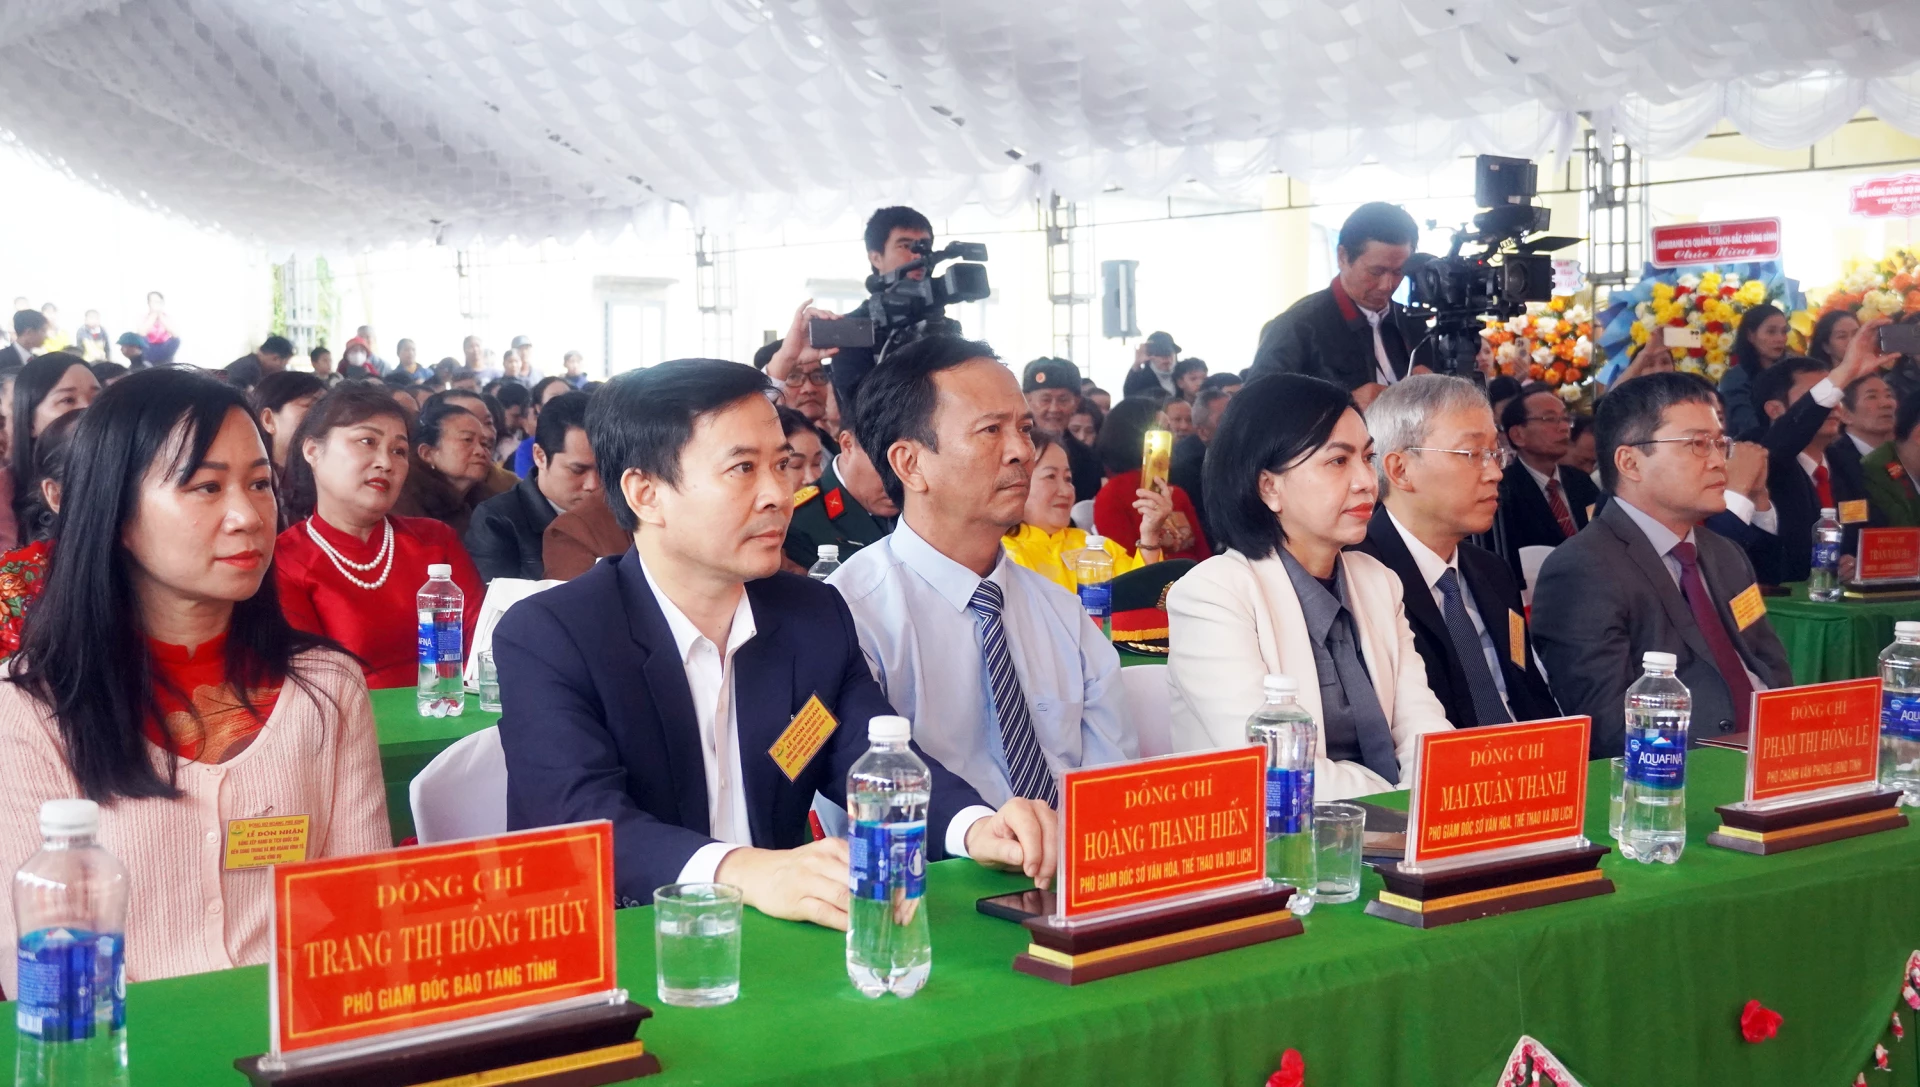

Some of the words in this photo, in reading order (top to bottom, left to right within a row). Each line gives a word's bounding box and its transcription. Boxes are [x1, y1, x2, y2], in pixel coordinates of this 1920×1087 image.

[1674, 248, 1709, 259] Chúc
[1791, 700, 1824, 720] ĐỒNG
[1827, 698, 1847, 715] CHÍ
[1470, 741, 1513, 768] ĐỒNG
[1518, 738, 1544, 760] CHÍ
[1638, 751, 1682, 766] AQUAFINA
[1762, 734, 1796, 763] PHẠM
[1800, 731, 1818, 758] THỊ
[1820, 718, 1853, 751] HỒNG
[1125, 779, 1176, 808] ĐỒNG
[1181, 773, 1212, 799] CHÍ
[1440, 784, 1469, 812] MAI
[1472, 772, 1514, 807] XUÂN
[1518, 766, 1567, 800] THÀNH
[1084, 819, 1144, 862] HOÀNG
[1149, 815, 1206, 850] THANH
[1210, 797, 1249, 839] HIẾN
[1428, 822, 1441, 841] PHÓ
[1443, 820, 1460, 838] GIÁM
[1461, 817, 1474, 836] ĐỐC
[1475, 814, 1484, 833] SỞ
[1485, 816, 1498, 832] VĂN
[1499, 814, 1512, 831] HÓA,
[1514, 808, 1525, 828] THỂ
[1527, 809, 1541, 826] THAO
[1542, 807, 1550, 822] VÀ
[1551, 807, 1560, 821] DU
[1560, 806, 1573, 824] LỊCH
[376, 869, 463, 909] ĐỒNG
[473, 857, 524, 893] CHÍ
[1080, 872, 1096, 894] PHÓ
[1098, 868, 1117, 891] GIÁM
[1119, 865, 1133, 887] ĐỐC
[1136, 861, 1146, 883] SỞ
[1148, 861, 1162, 880] VĂN
[1164, 858, 1179, 878] HÓA,
[1182, 851, 1194, 874] THỂ
[1196, 853, 1214, 872] THAO
[1216, 849, 1224, 868] VÀ
[1226, 850, 1235, 867] DU
[1237, 847, 1252, 868] LỊCH
[304, 930, 392, 979] TRANG
[400, 920, 443, 967] THỊ
[450, 899, 520, 954] HỒNG
[524, 890, 589, 941] THÚY
[343, 987, 373, 1017] PHÓ
[378, 980, 416, 1011] GIÁM
[420, 974, 449, 1003] ĐỐC
[453, 967, 482, 997] BẢO
[486, 961, 522, 990] TÀNG
[527, 955, 557, 983] TỈNH
